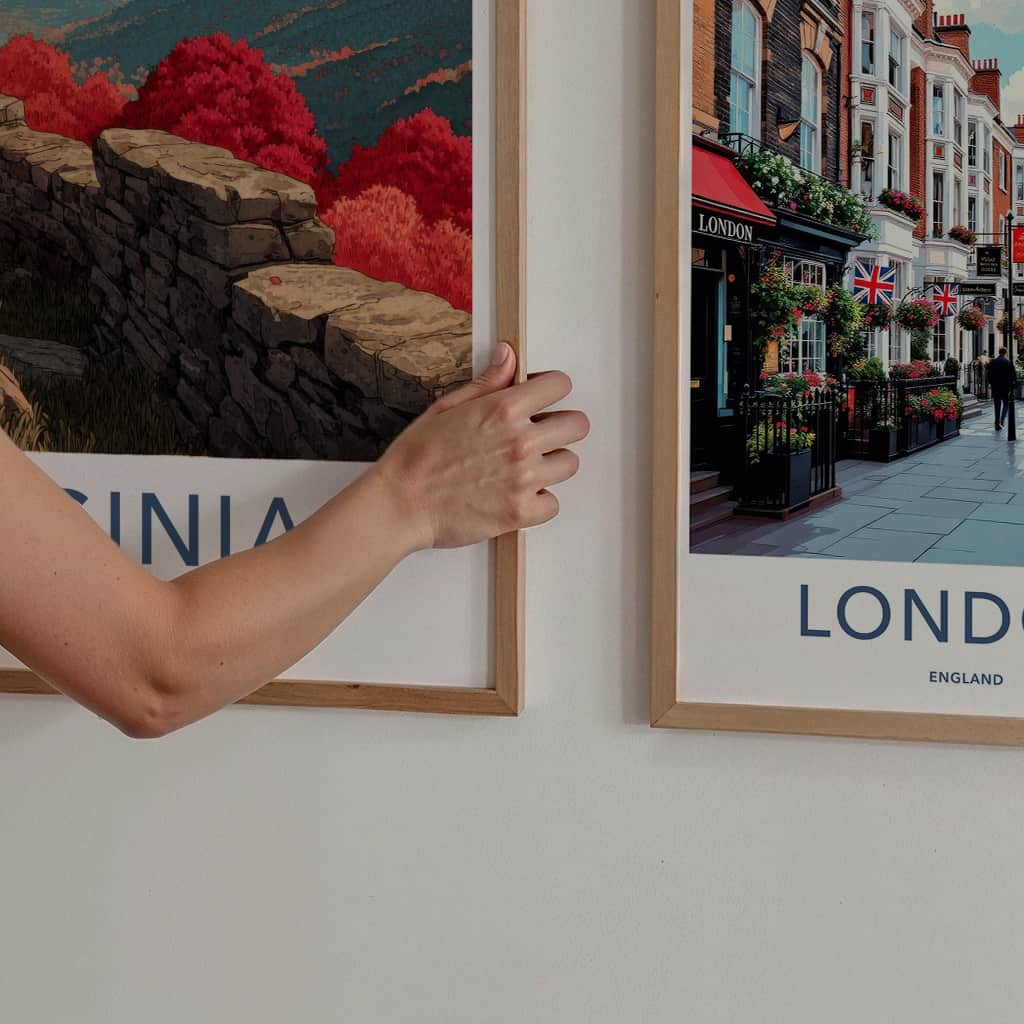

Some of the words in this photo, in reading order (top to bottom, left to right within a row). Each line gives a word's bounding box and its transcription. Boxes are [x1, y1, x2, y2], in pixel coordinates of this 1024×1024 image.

[698, 213, 753, 242] LONDON
[800, 584, 1024, 645] LOND
[929, 671, 1004, 686] ENGLAND
